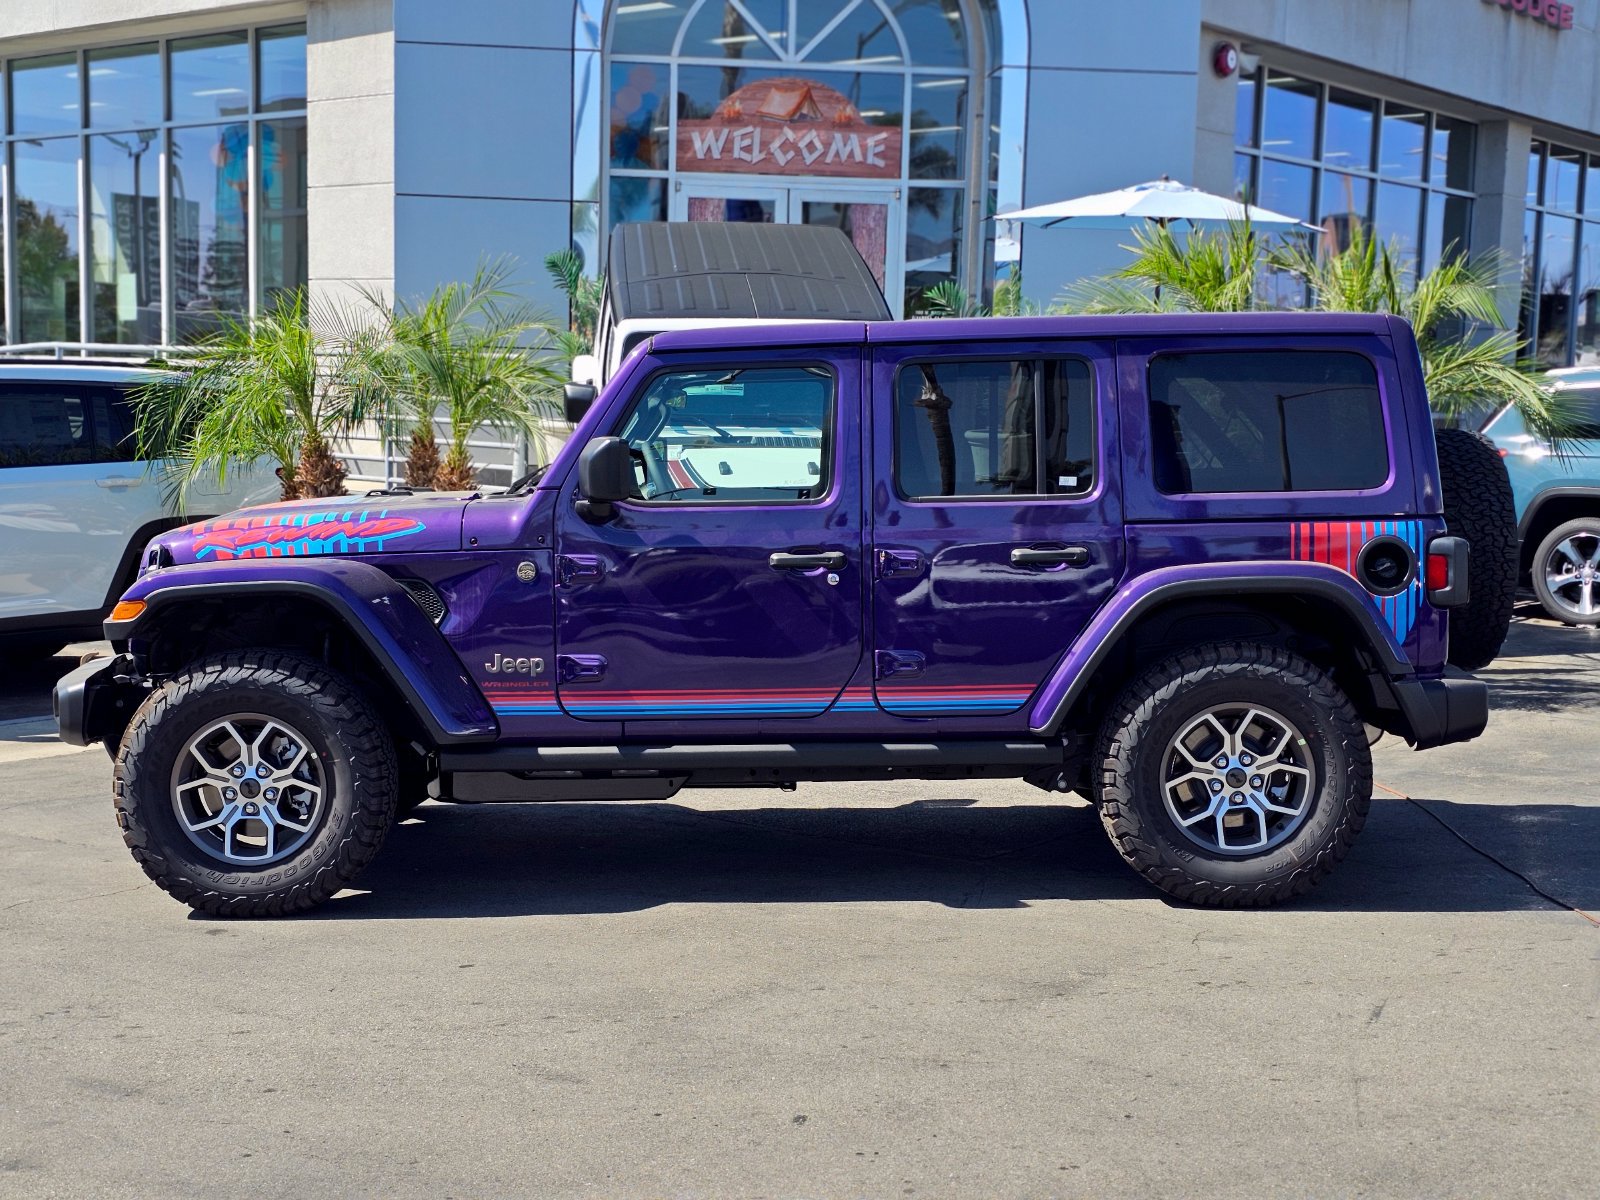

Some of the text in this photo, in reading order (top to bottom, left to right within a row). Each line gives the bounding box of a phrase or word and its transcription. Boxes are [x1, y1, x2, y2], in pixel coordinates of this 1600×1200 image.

[1495, 0, 1574, 30] DGE
[690, 125, 888, 168] WELCOME
[485, 653, 545, 677] Jeep
